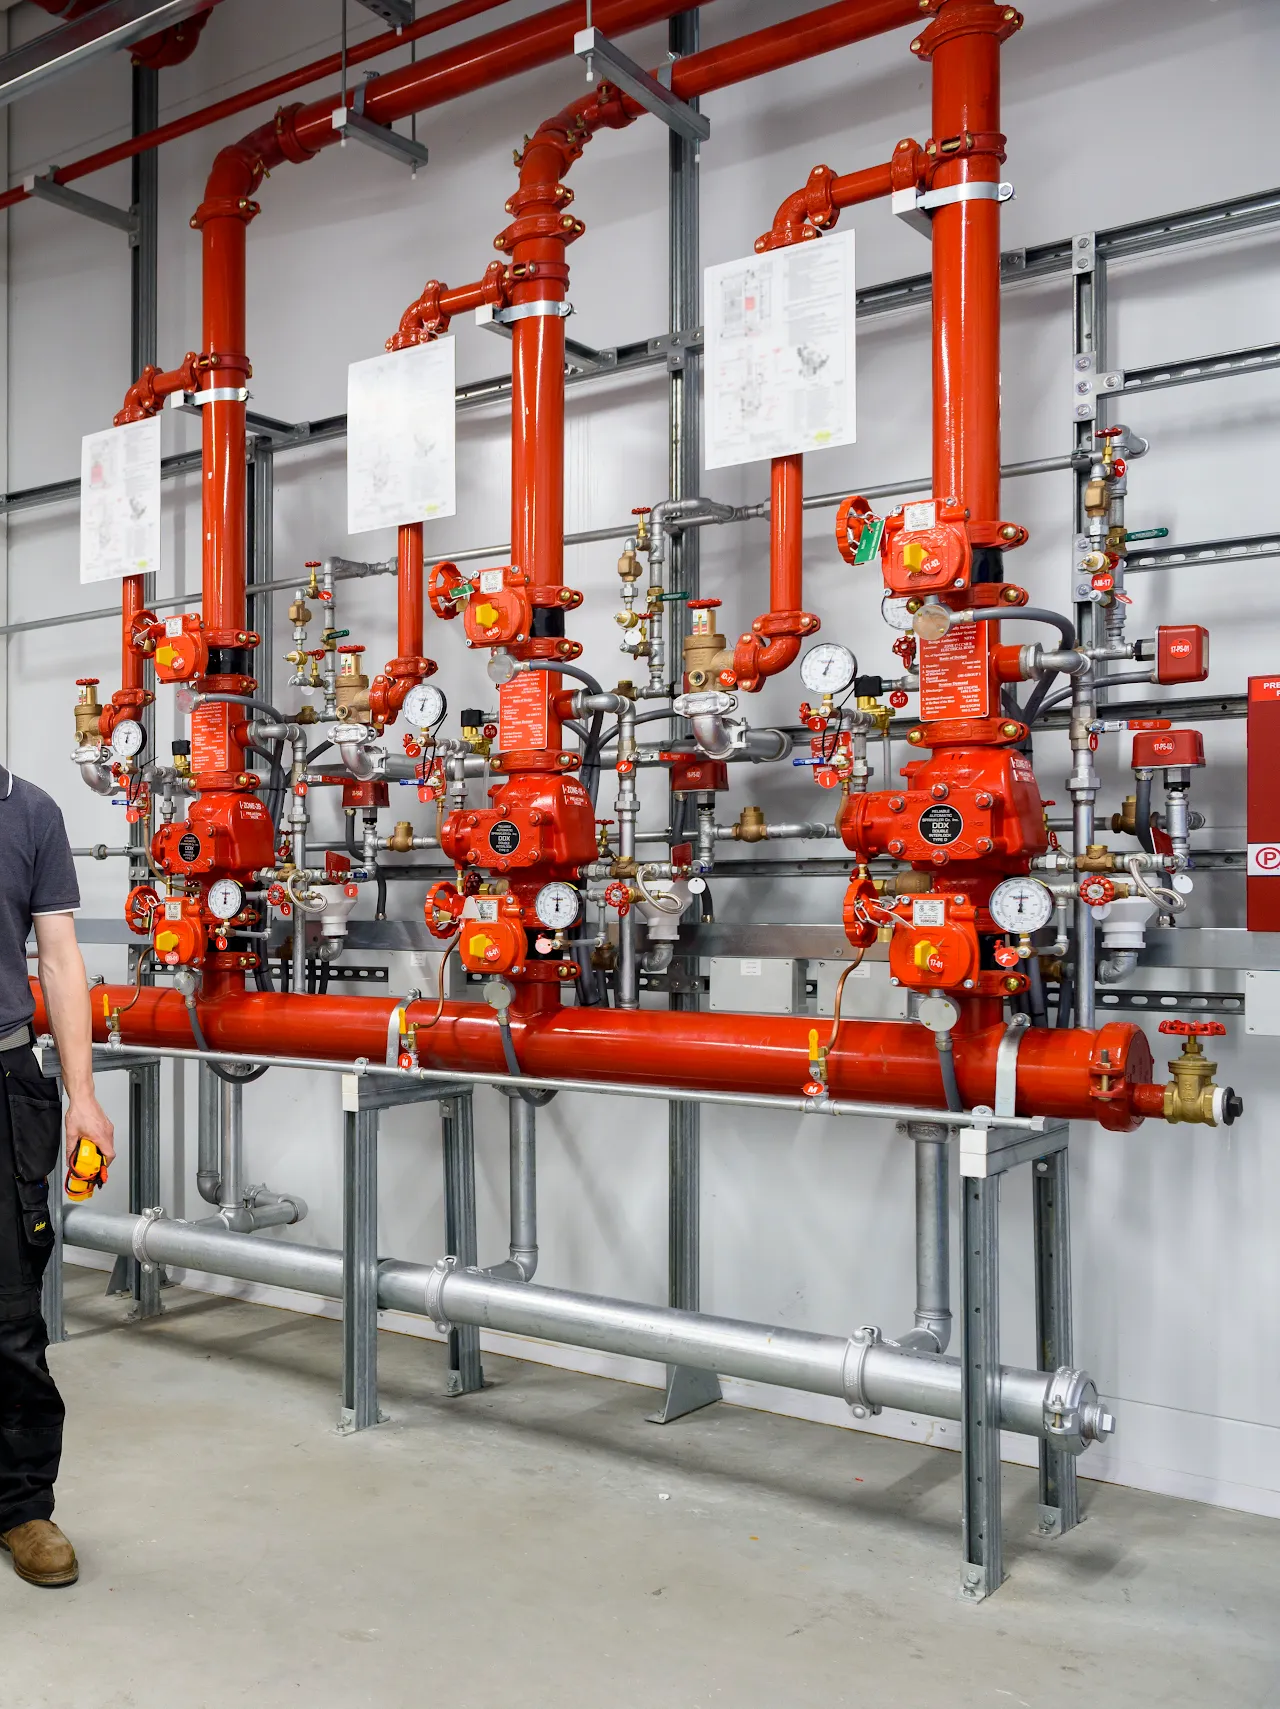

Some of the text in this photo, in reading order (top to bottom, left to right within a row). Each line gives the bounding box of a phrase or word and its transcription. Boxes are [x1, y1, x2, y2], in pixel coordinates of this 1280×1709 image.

[1154, 742, 1172, 751] 17-PS-02
[999, 953, 1012, 963] K
[930, 959, 943, 968] 17-01
[402, 1058, 408, 1066] M
